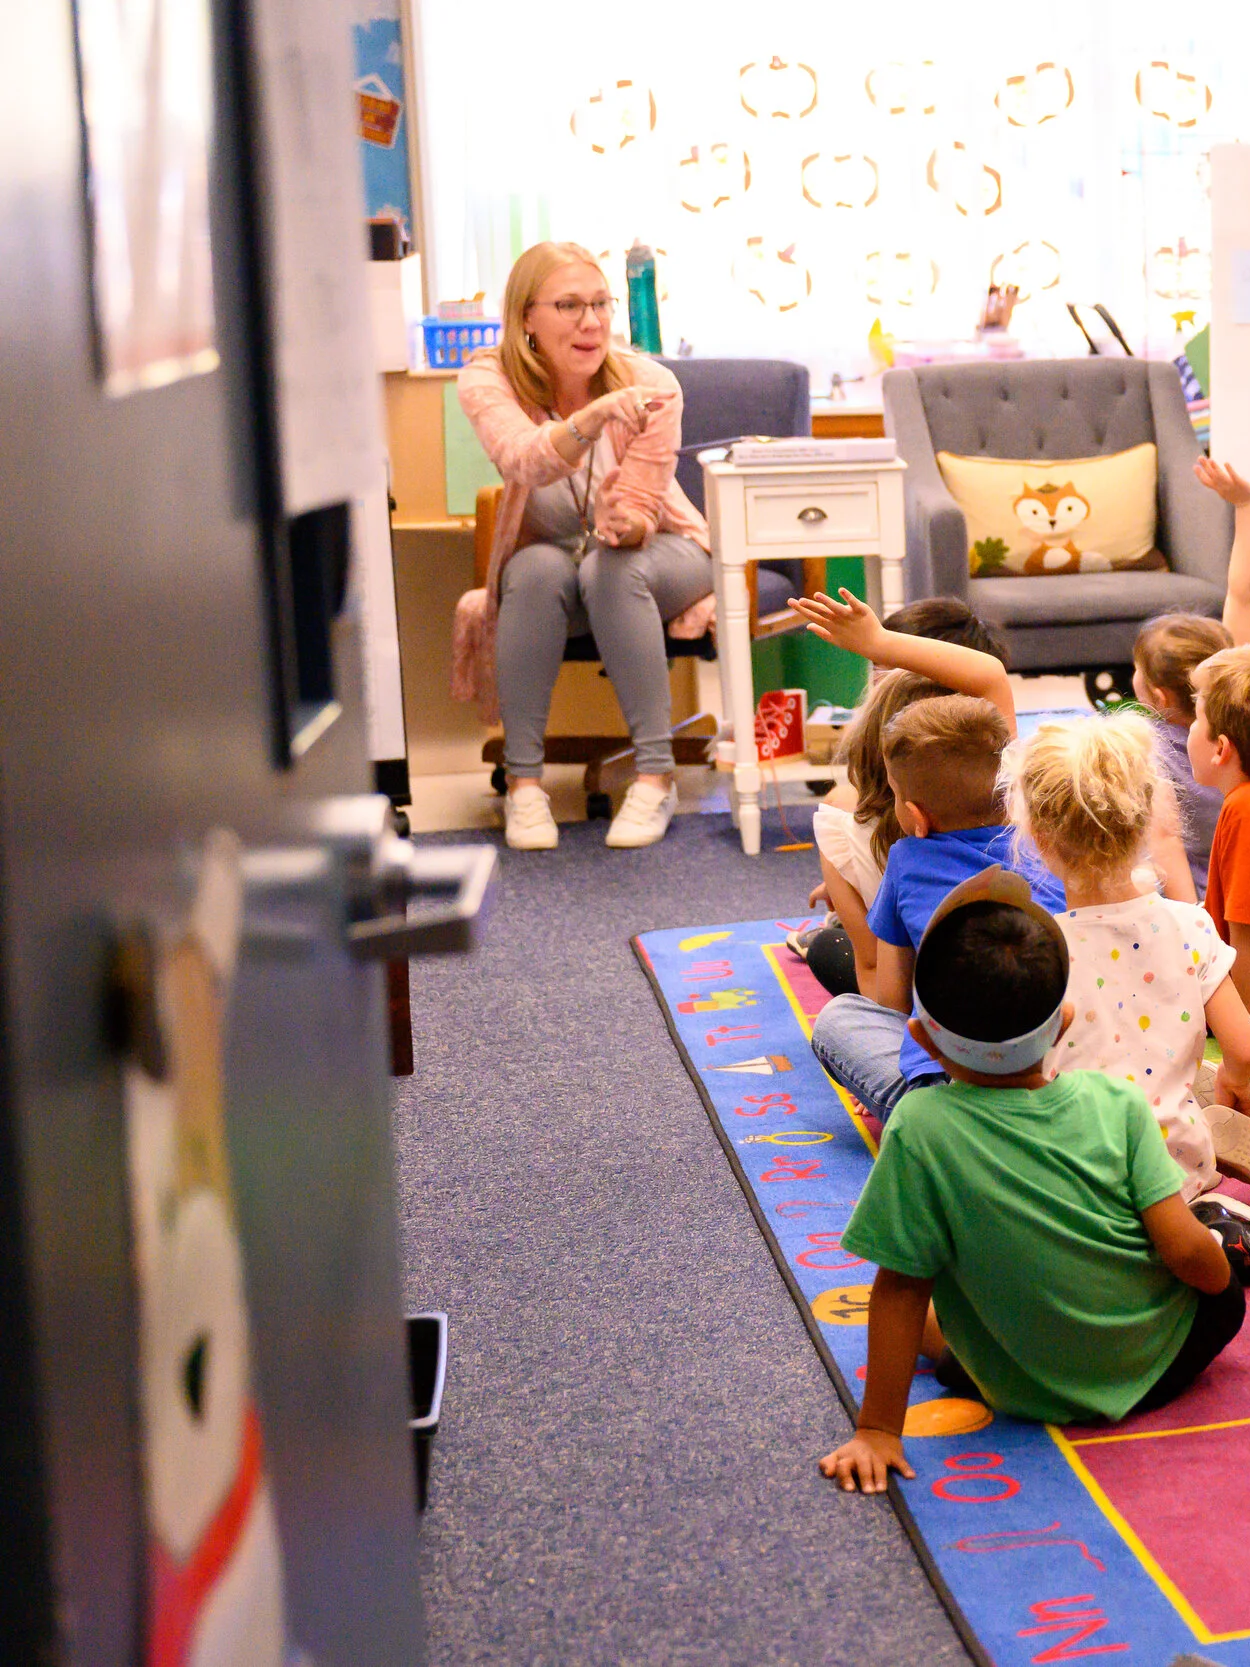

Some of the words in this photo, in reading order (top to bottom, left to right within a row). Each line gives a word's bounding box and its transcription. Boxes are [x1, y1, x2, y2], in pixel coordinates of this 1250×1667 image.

[734, 1093, 798, 1117] Ss
[760, 1155, 828, 1183] Rr
[931, 1452, 1021, 1503] Oo
[1016, 1594, 1130, 1664] Nn
